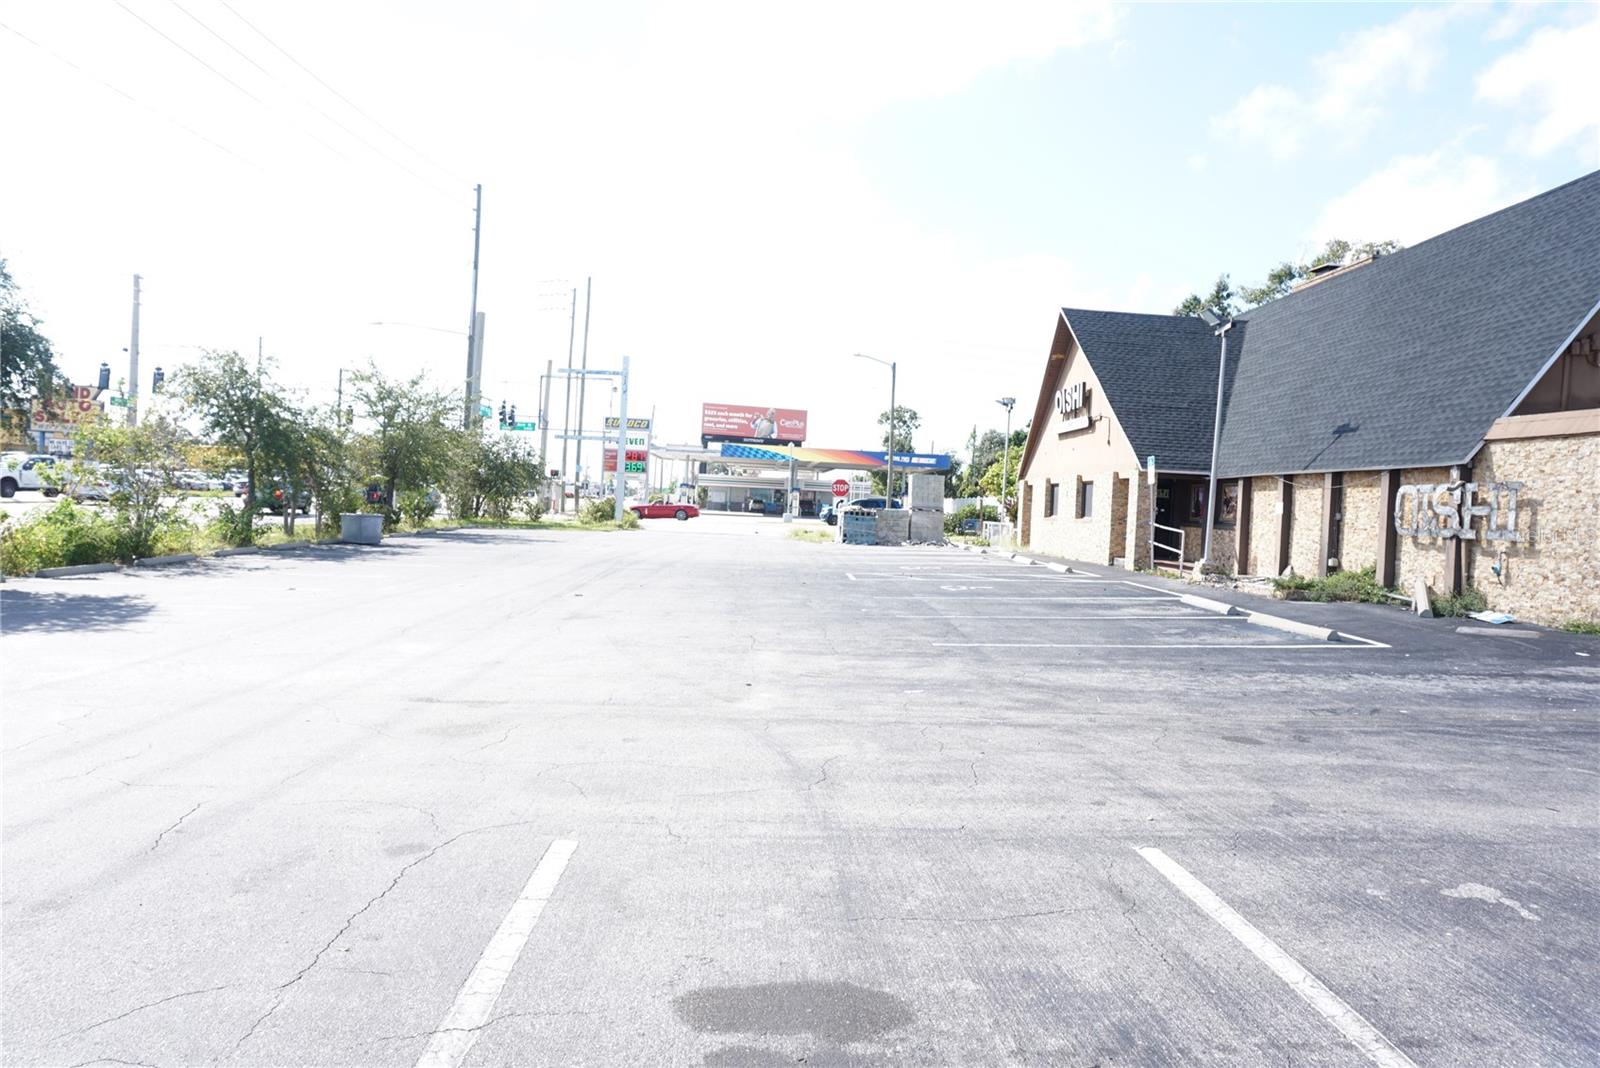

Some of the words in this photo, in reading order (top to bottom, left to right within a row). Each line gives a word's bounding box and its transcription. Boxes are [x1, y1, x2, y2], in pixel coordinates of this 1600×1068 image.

[1055, 383, 1083, 413] OISHI
[606, 418, 649, 427] SUOCO
[832, 484, 849, 492] STOP
[1394, 482, 1523, 541] OISHI
